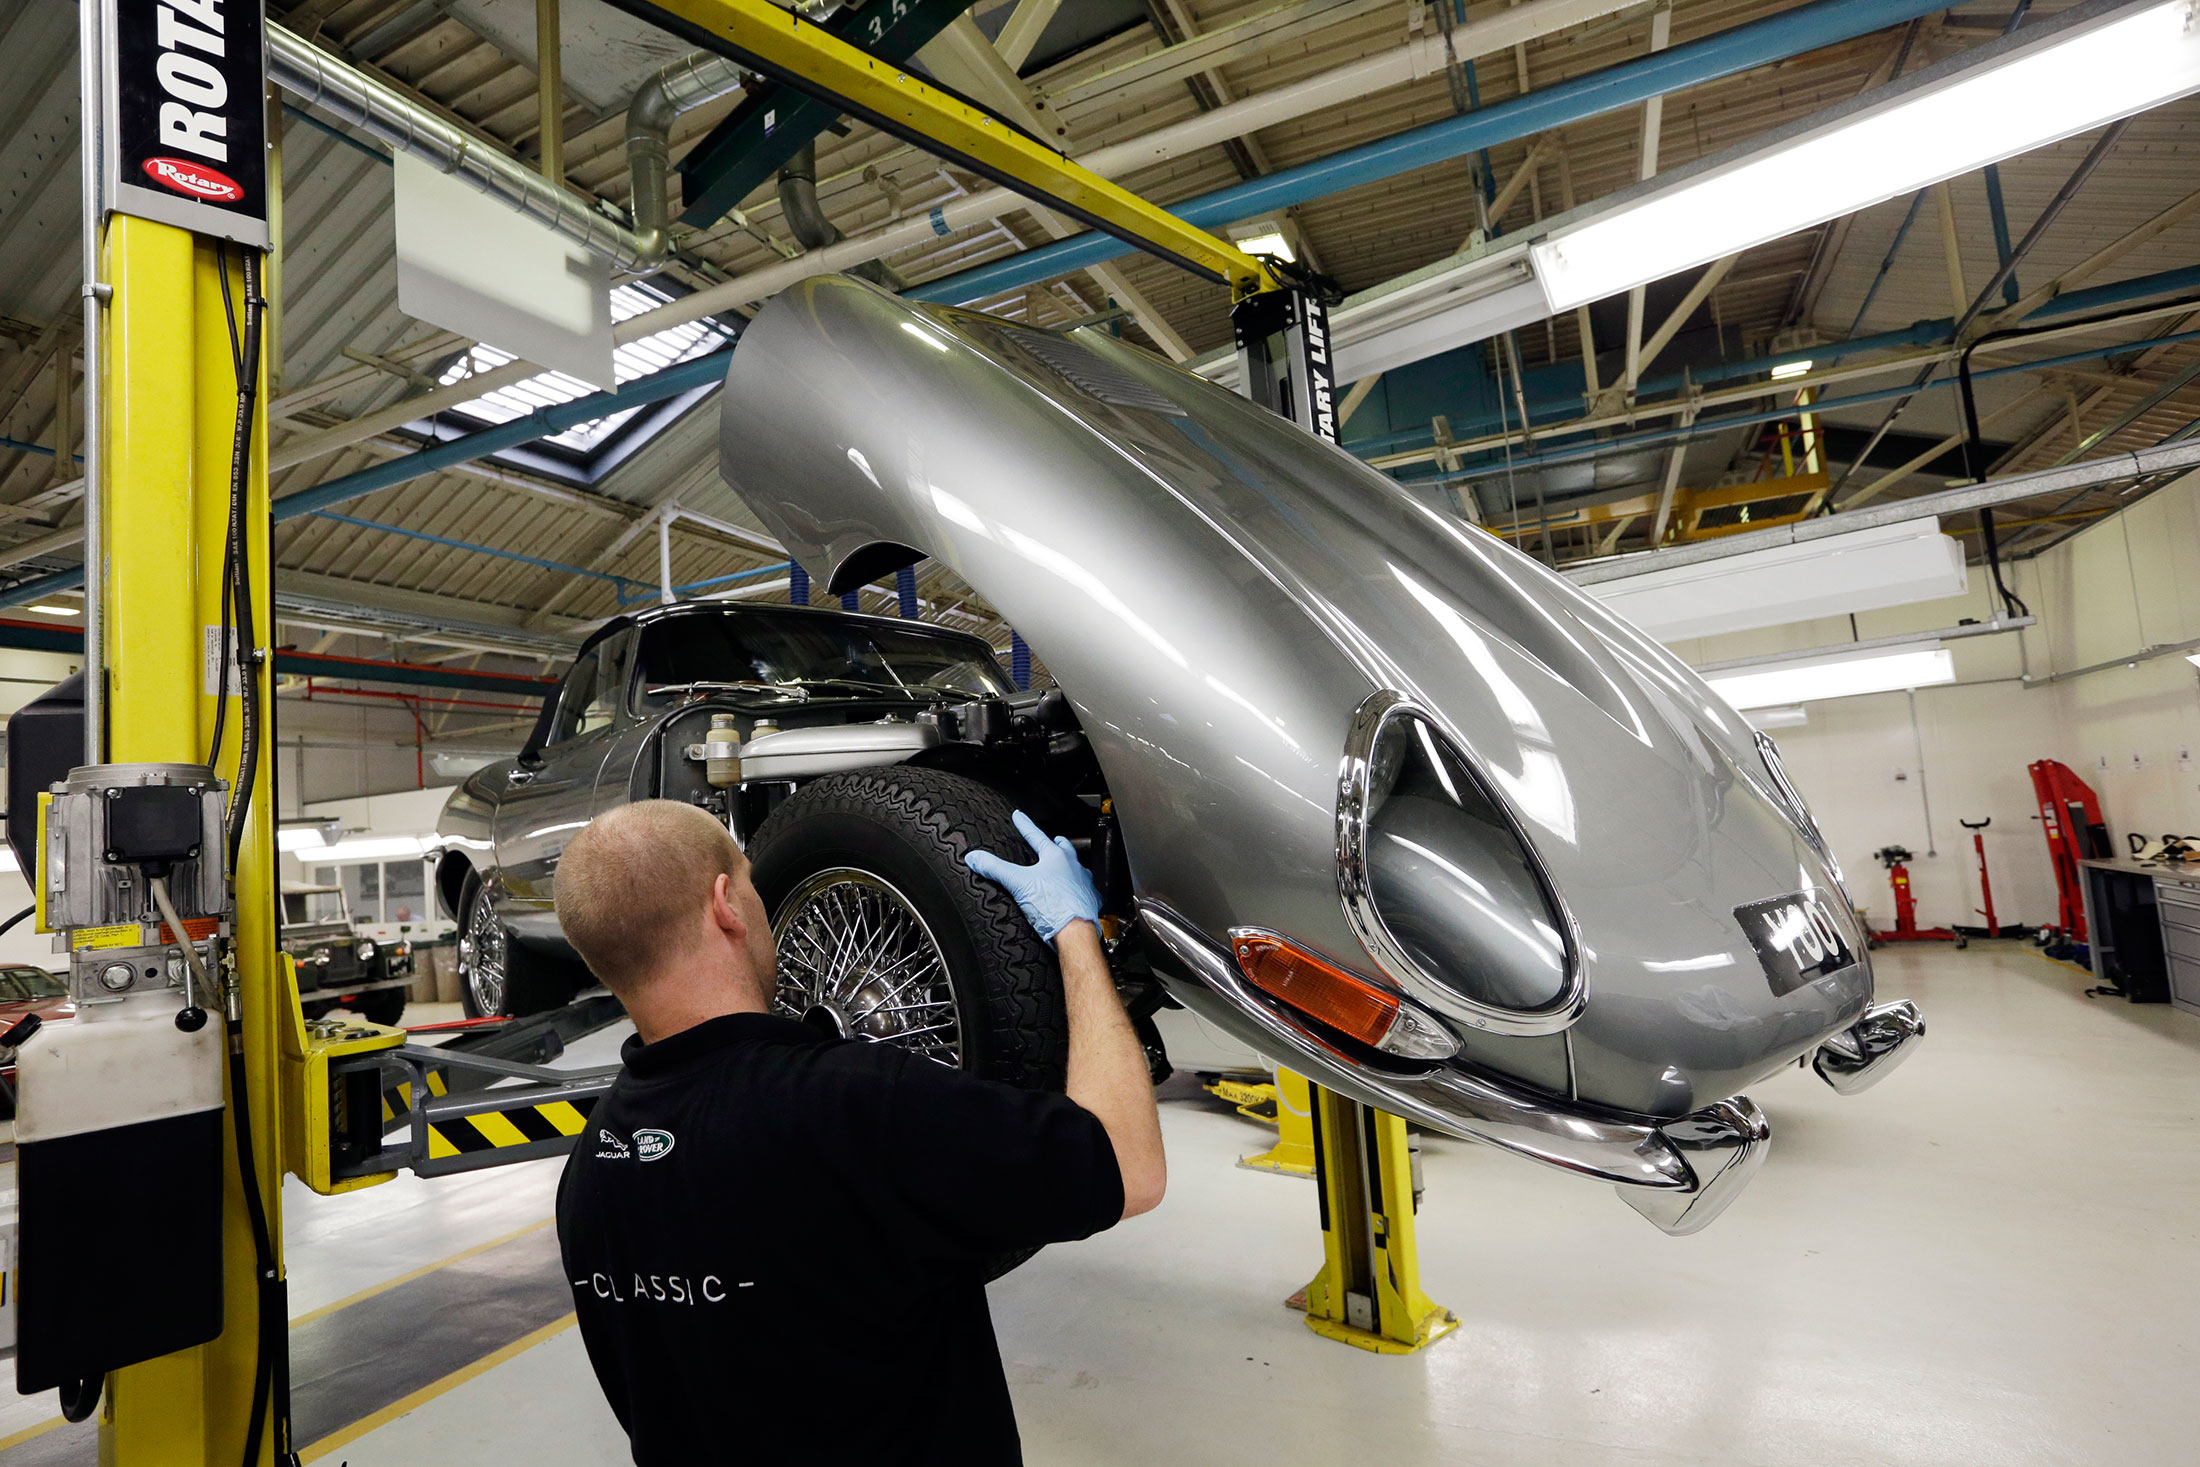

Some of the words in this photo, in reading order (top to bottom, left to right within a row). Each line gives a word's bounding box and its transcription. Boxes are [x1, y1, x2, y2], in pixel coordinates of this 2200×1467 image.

[154, 158, 234, 195] Rotary
[1305, 298, 1327, 365] LIFT
[637, 1135, 654, 1145] LAND
[595, 1150, 631, 1159] JAGUAR
